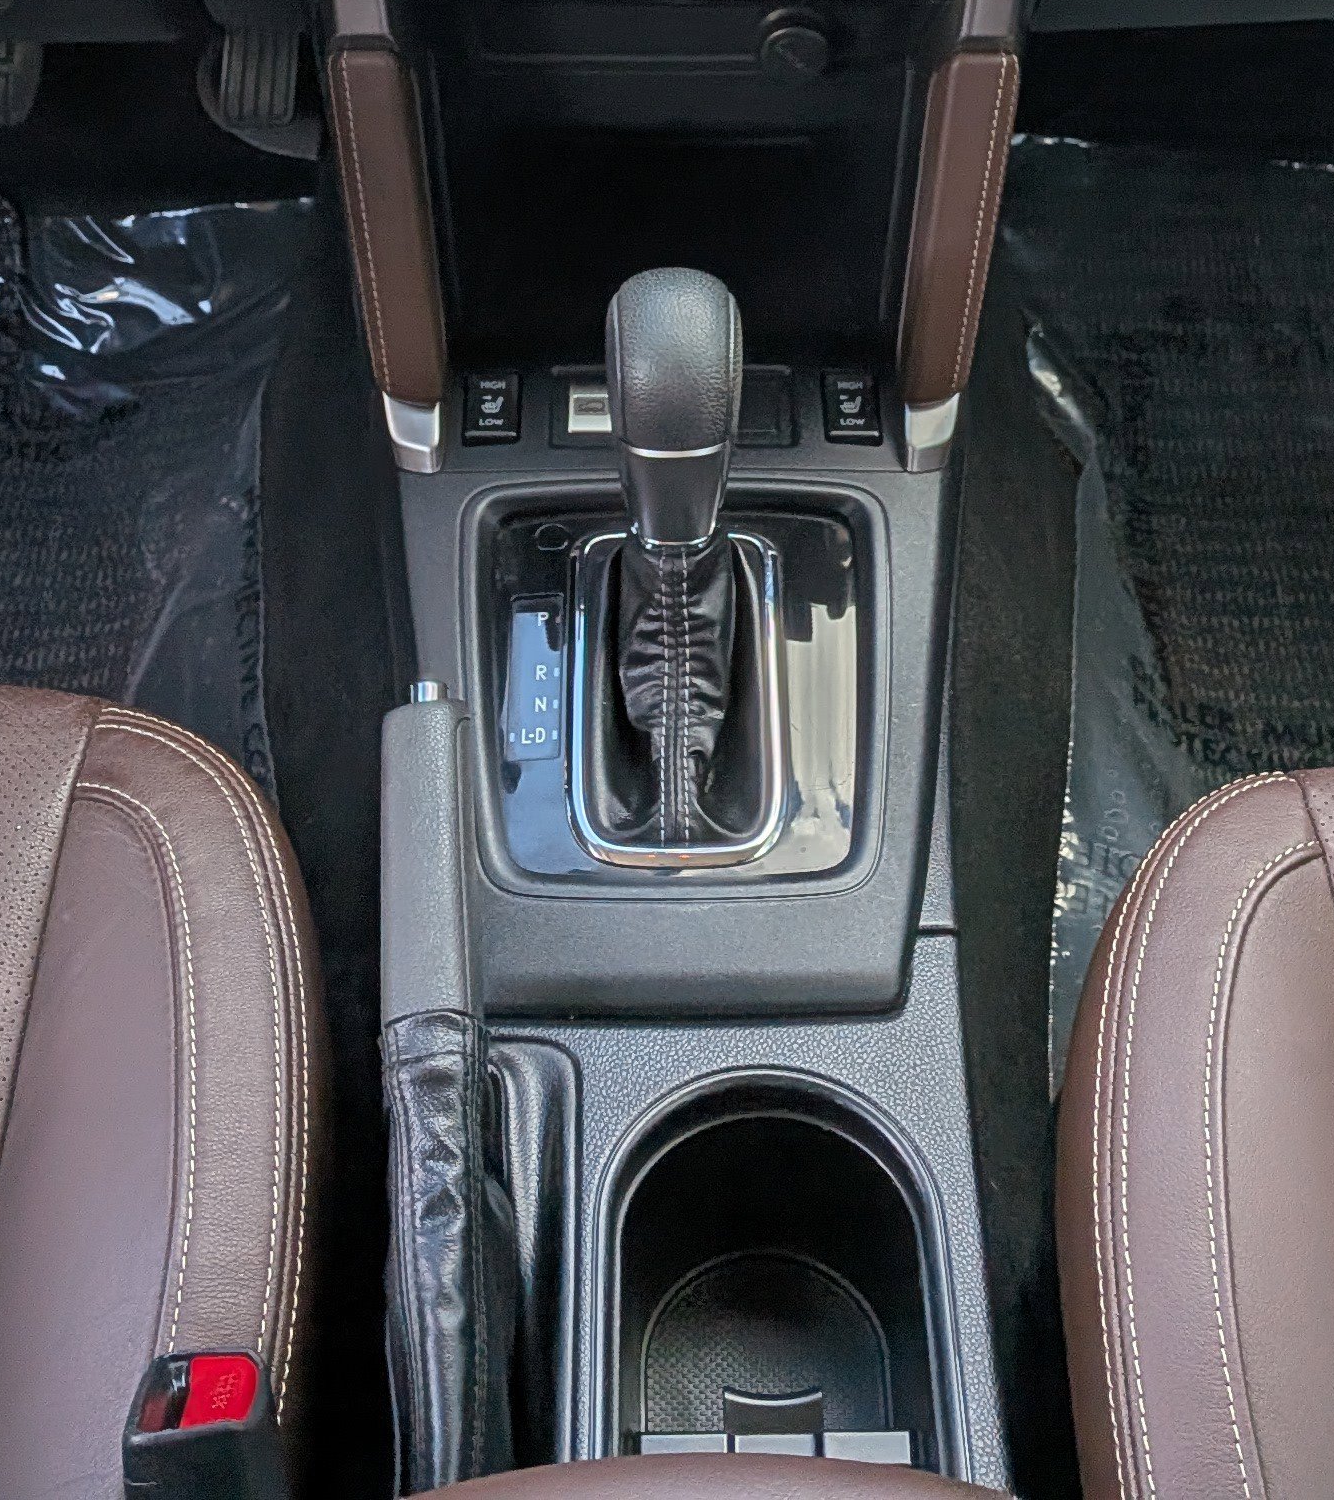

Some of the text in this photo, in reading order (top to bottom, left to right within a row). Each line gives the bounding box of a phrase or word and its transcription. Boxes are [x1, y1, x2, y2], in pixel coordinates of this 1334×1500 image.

[480, 380, 864, 390] HIGH HIGH
[479, 418, 865, 426] LOW LOW
[537, 611, 550, 626] P
[535, 664, 547, 680] R
[534, 696, 547, 712] N
